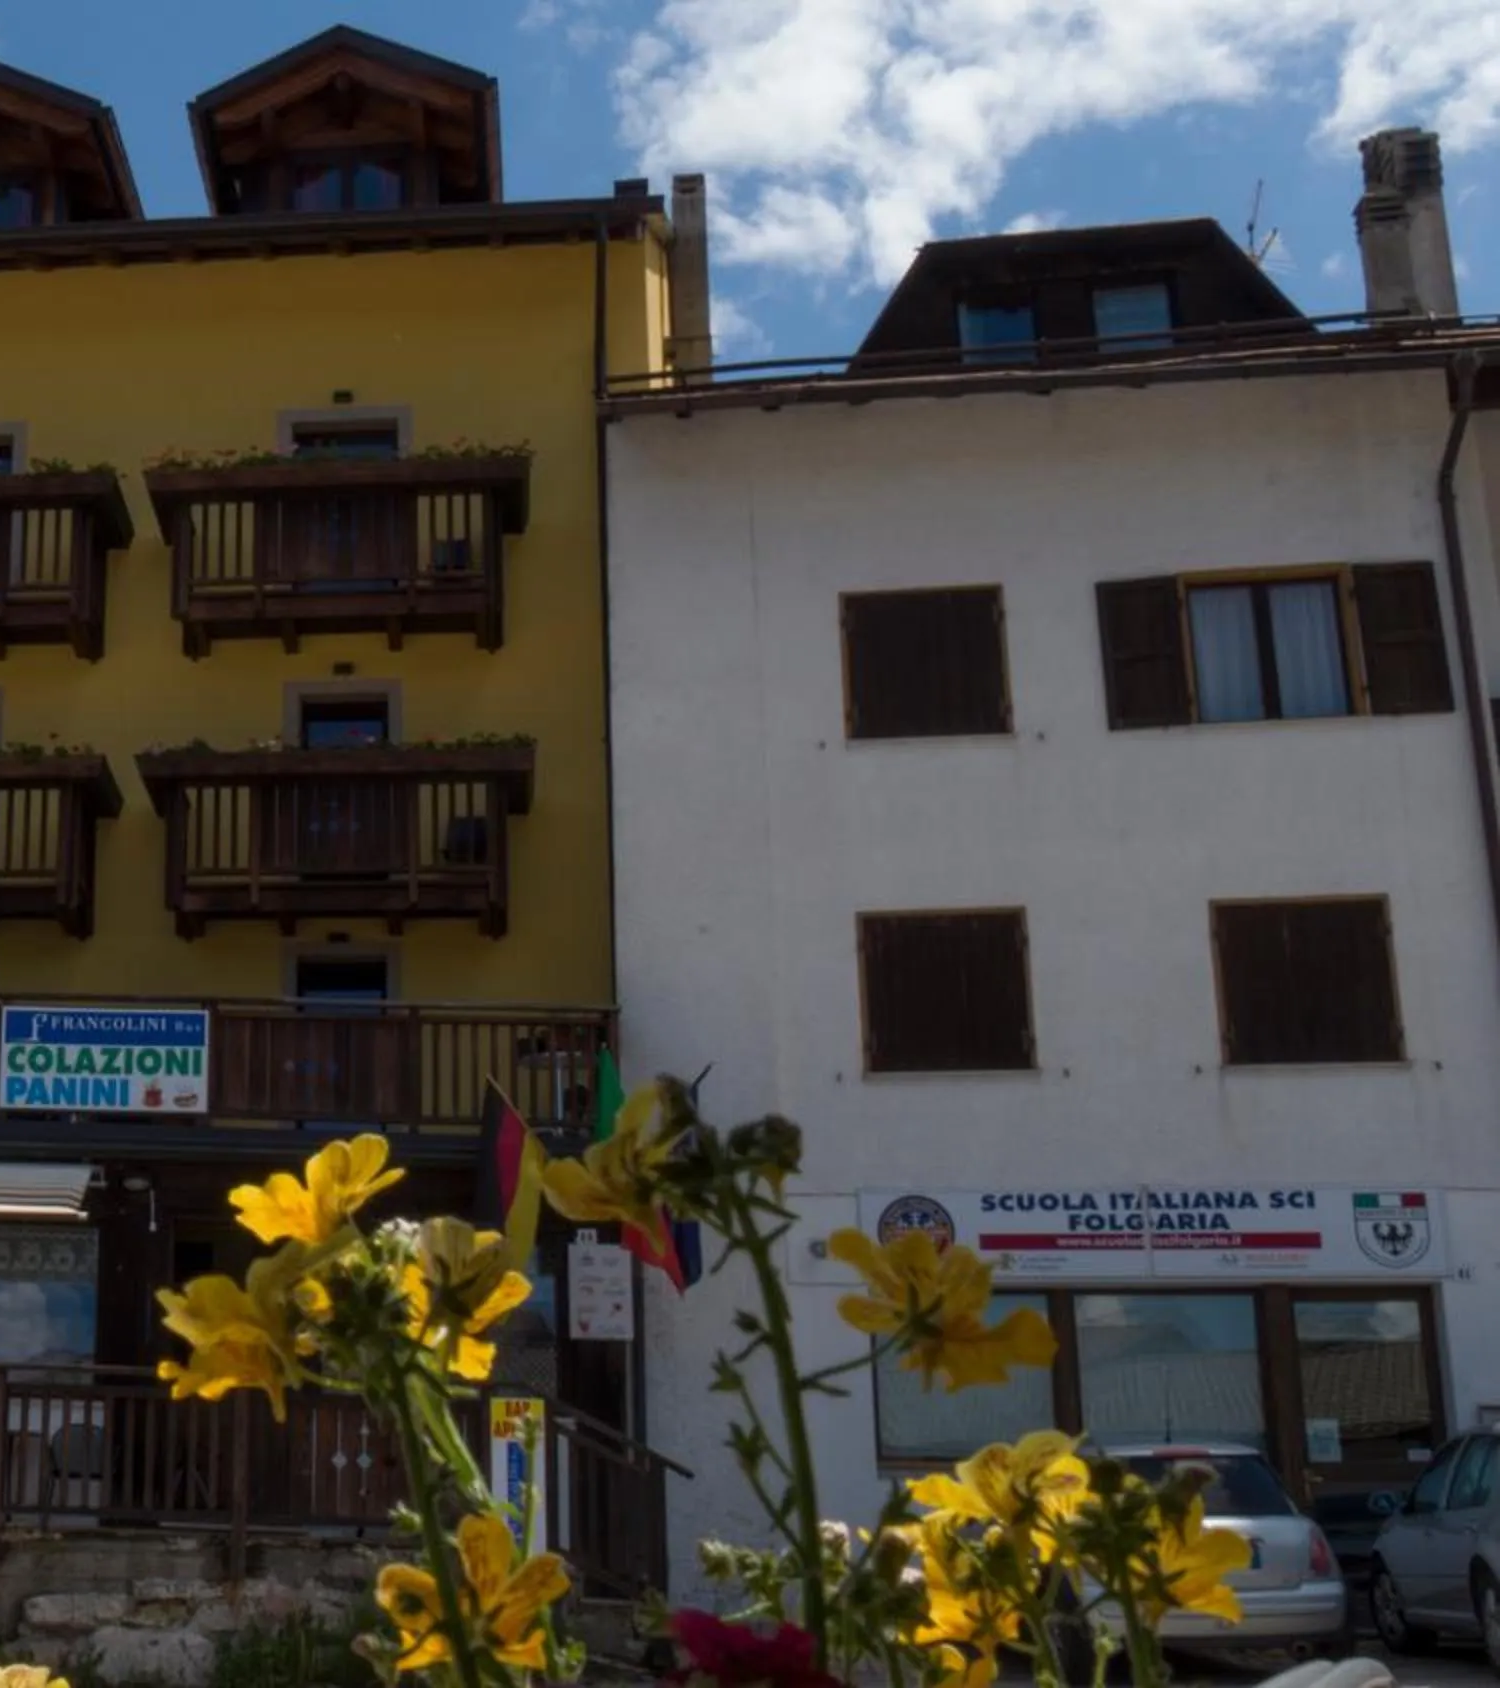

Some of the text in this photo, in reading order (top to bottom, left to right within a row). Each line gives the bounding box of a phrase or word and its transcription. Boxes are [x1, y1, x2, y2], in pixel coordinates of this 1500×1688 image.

[50, 1016, 168, 1032] FRANCOLINI
[7, 1045, 203, 1076] COLAZIONI
[5, 1076, 130, 1107] PANINI
[980, 1190, 1316, 1212] SCUOLA ITALIANA SCI
[1067, 1212, 1231, 1231] FOLGARIA
